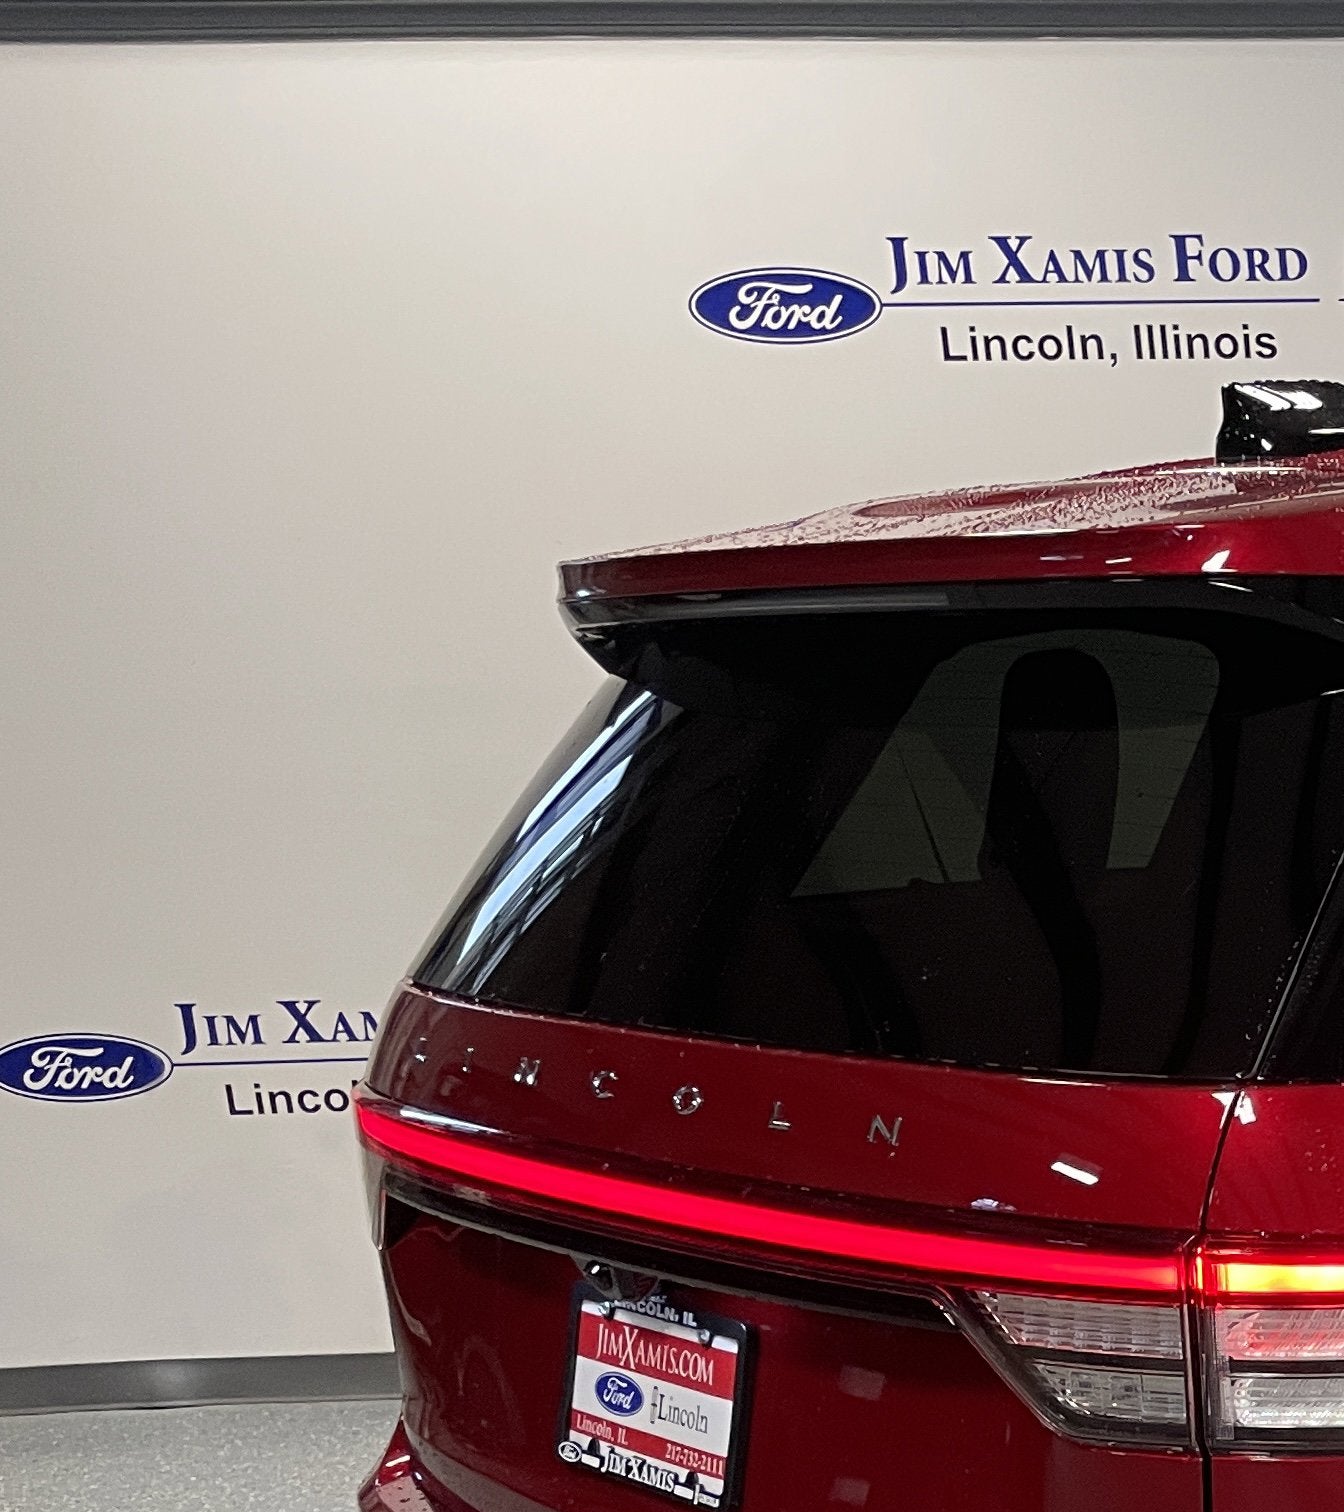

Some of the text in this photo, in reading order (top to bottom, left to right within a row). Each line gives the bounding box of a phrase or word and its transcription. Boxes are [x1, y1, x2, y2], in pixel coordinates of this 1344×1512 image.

[885, 233, 1308, 295] JIM XAMIS FORD
[728, 281, 844, 332] Ford
[940, 323, 1278, 368] Lincoln, Illinois
[173, 1003, 266, 1055] JIM
[22, 1046, 135, 1091] Ford
[225, 1080, 356, 1116] Linco
[414, 1036, 902, 1148] LINCOLN
[595, 1322, 715, 1386] JIMXAMIS.COM
[602, 1376, 635, 1410] Ford
[657, 1393, 709, 1435] Lincoln
[601, 1448, 627, 1477] JIM
[627, 1456, 676, 1492] XAMIS
